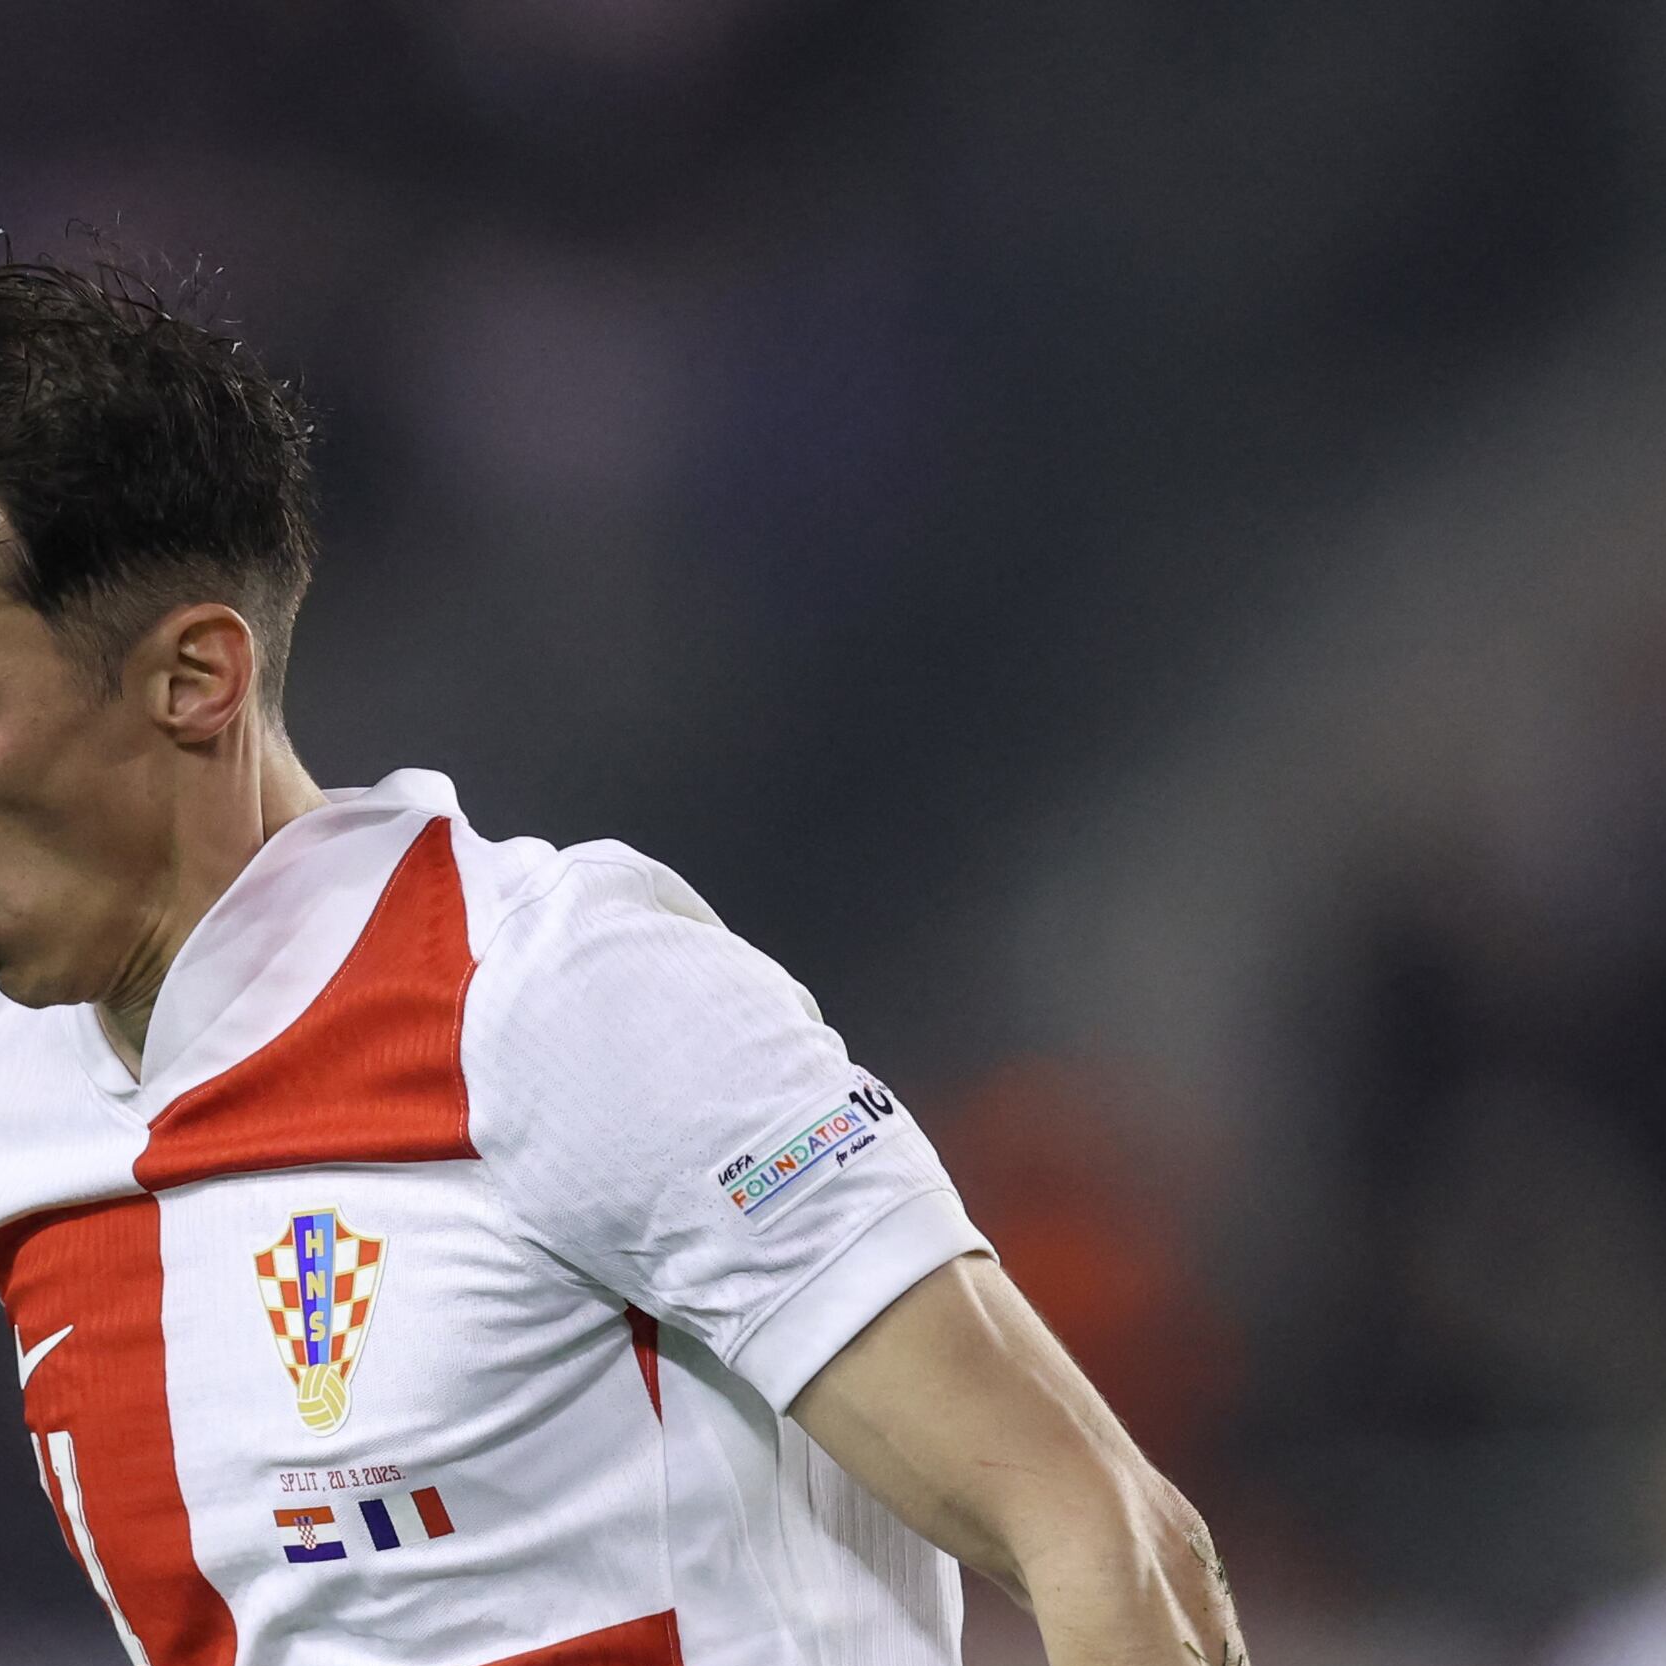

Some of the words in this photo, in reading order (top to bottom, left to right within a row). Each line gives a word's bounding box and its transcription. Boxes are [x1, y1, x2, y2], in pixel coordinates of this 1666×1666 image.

[718, 1154, 754, 1185] UEFA
[731, 1109, 862, 1209] FOUNDATION
[836, 1151, 848, 1168] for
[305, 1229, 326, 1342] HNS
